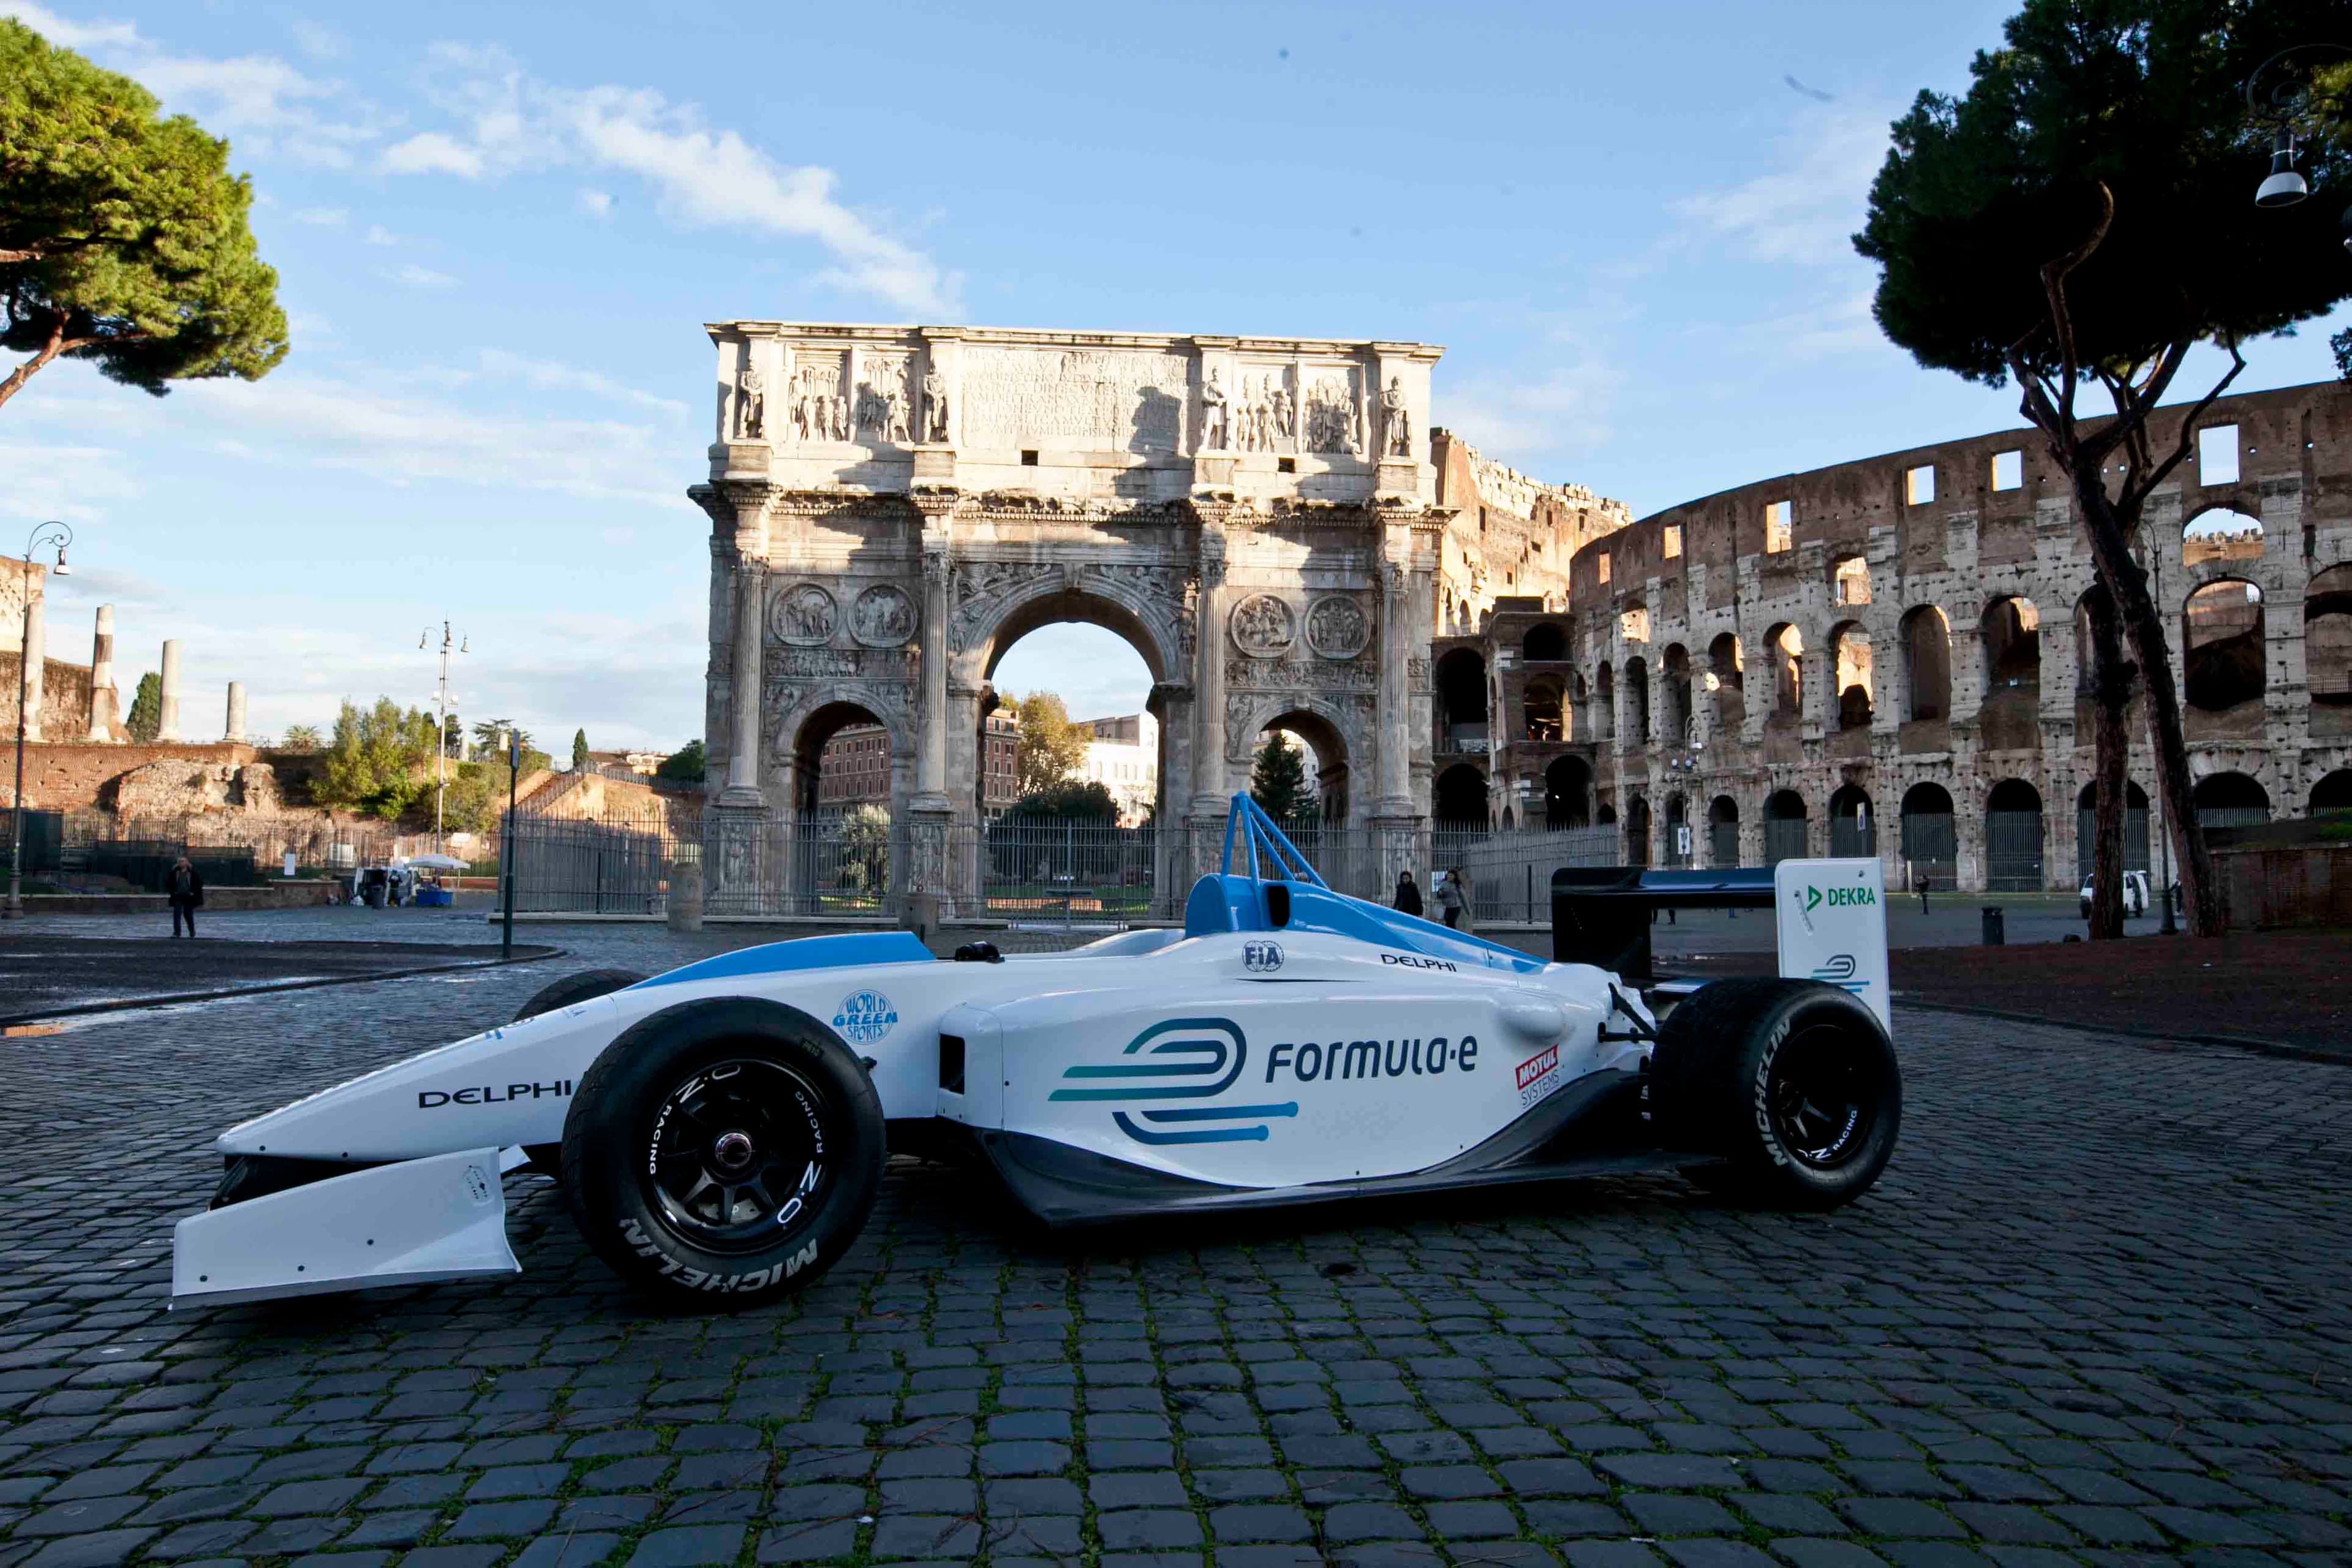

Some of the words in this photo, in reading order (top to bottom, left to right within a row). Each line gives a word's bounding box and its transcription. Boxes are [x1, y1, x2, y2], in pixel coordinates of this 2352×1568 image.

[1828, 887, 1875, 907] DEKRA
[1381, 953, 1457, 972] DELPHI
[833, 1012, 898, 1027] GREEN
[846, 994, 886, 1013] WORLD
[848, 1025, 883, 1040] SPORTS
[1519, 1049, 1556, 1086] MOTUL
[418, 1079, 571, 1109] DELPHI
[1521, 1069, 1559, 1106] SYSTEMS
[1755, 1017, 1790, 1166] MICHELIN
[649, 1104, 673, 1175] RACING
[796, 1091, 824, 1153] RACING
[1833, 1110, 1858, 1152] RACING
[619, 1218, 819, 1293] MICHELIN
